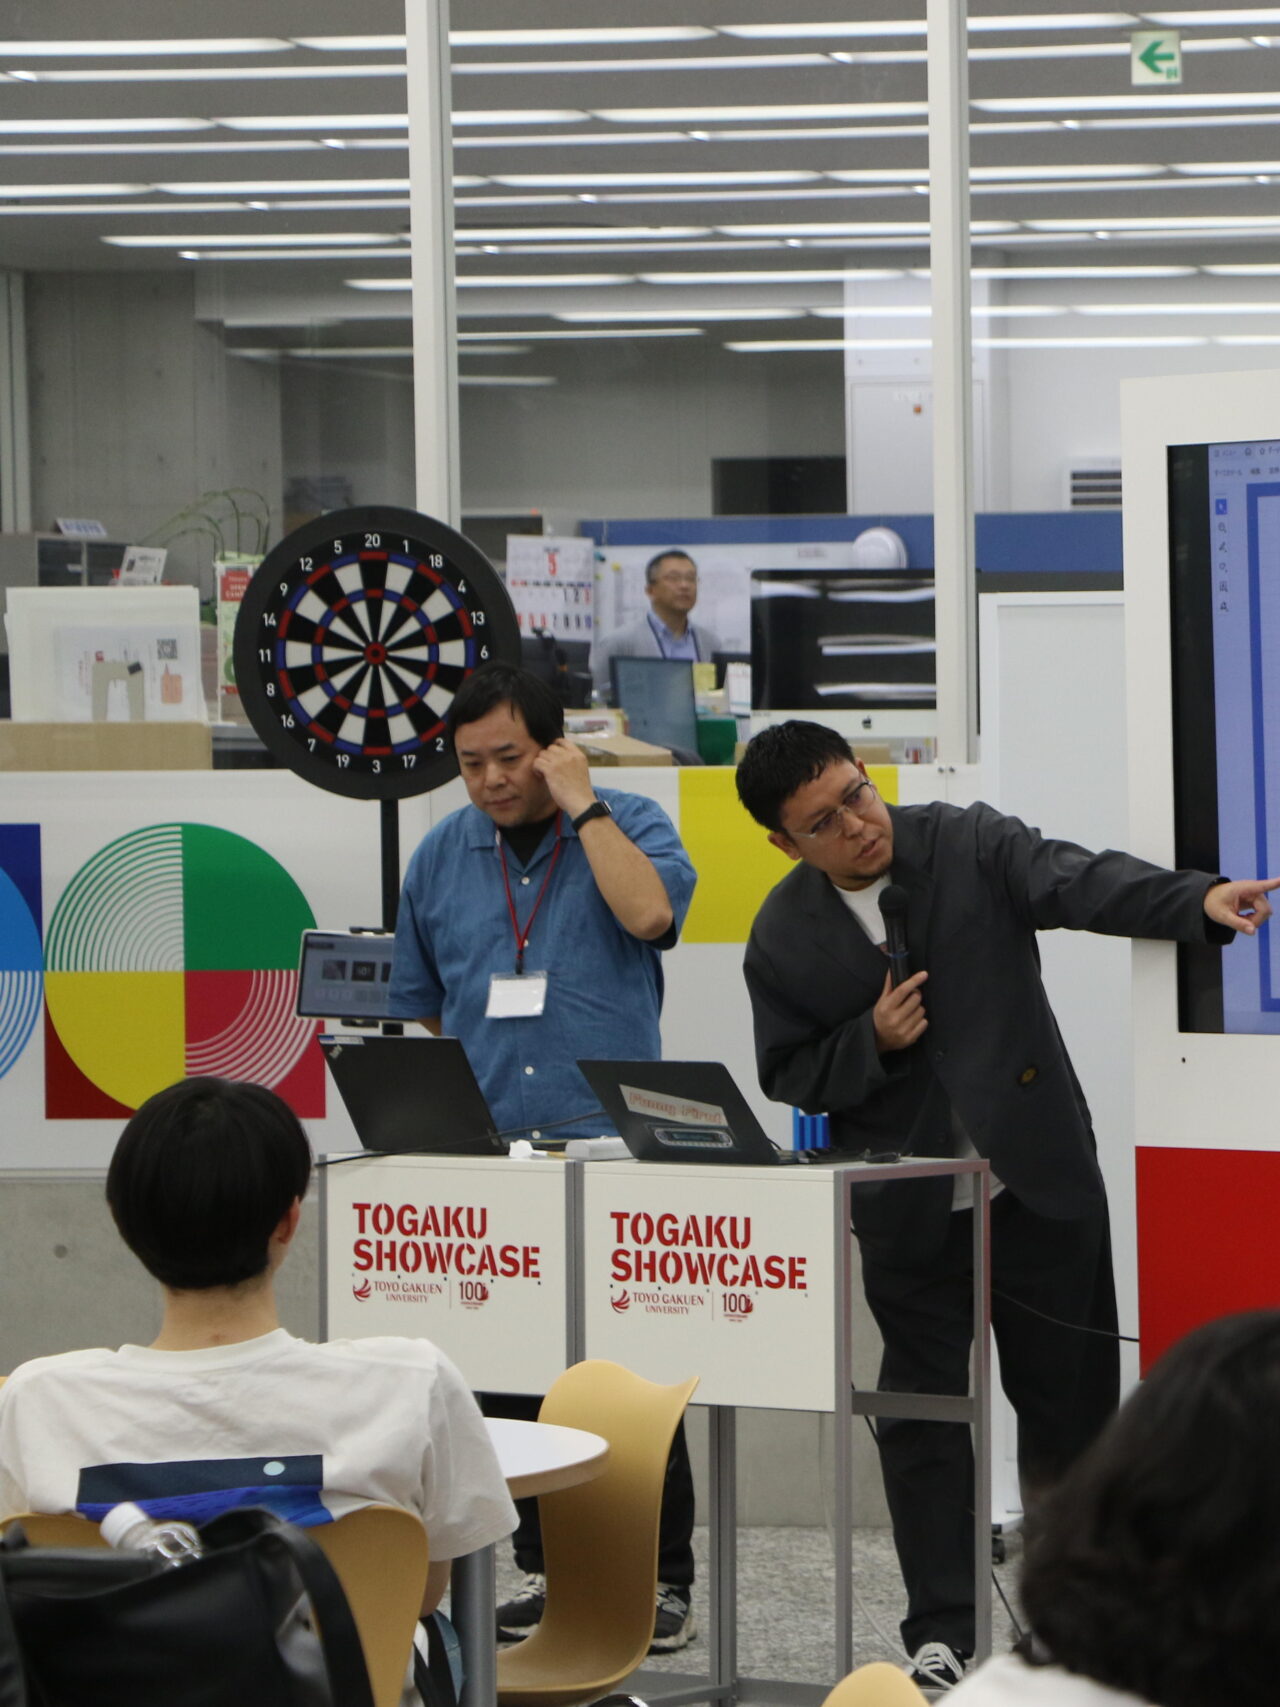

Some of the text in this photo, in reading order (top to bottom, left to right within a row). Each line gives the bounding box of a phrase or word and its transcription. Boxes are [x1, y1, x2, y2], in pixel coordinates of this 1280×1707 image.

[334, 540, 342, 553] 5
[365, 534, 381, 548] 20
[403, 540, 409, 552] 1
[300, 558, 313, 571] 12
[429, 554, 443, 567] 18
[280, 583, 288, 595] 9
[458, 580, 466, 593] 4
[263, 613, 276, 626] 14
[471, 611, 485, 625] 13
[259, 649, 271, 662] 11
[480, 645, 488, 658] 6
[267, 683, 275, 696] 8
[281, 714, 295, 728] 16
[308, 738, 316, 751] 7
[436, 738, 444, 751] 2
[337, 755, 349, 768] 19
[373, 760, 381, 773] 3
[402, 755, 416, 768] 17
[352, 1202, 487, 1240] TOGAKU
[610, 1212, 752, 1250] TOGAKU
[353, 1238, 541, 1278] SHOWCASE
[611, 1248, 808, 1290] SHOWCASE
[374, 1281, 443, 1294] TOYO GAKUEN
[386, 1293, 429, 1304] UNIVERSITY
[633, 1292, 705, 1306] TOYO GAKUEN
[645, 1304, 690, 1315] UNIVERSITY
